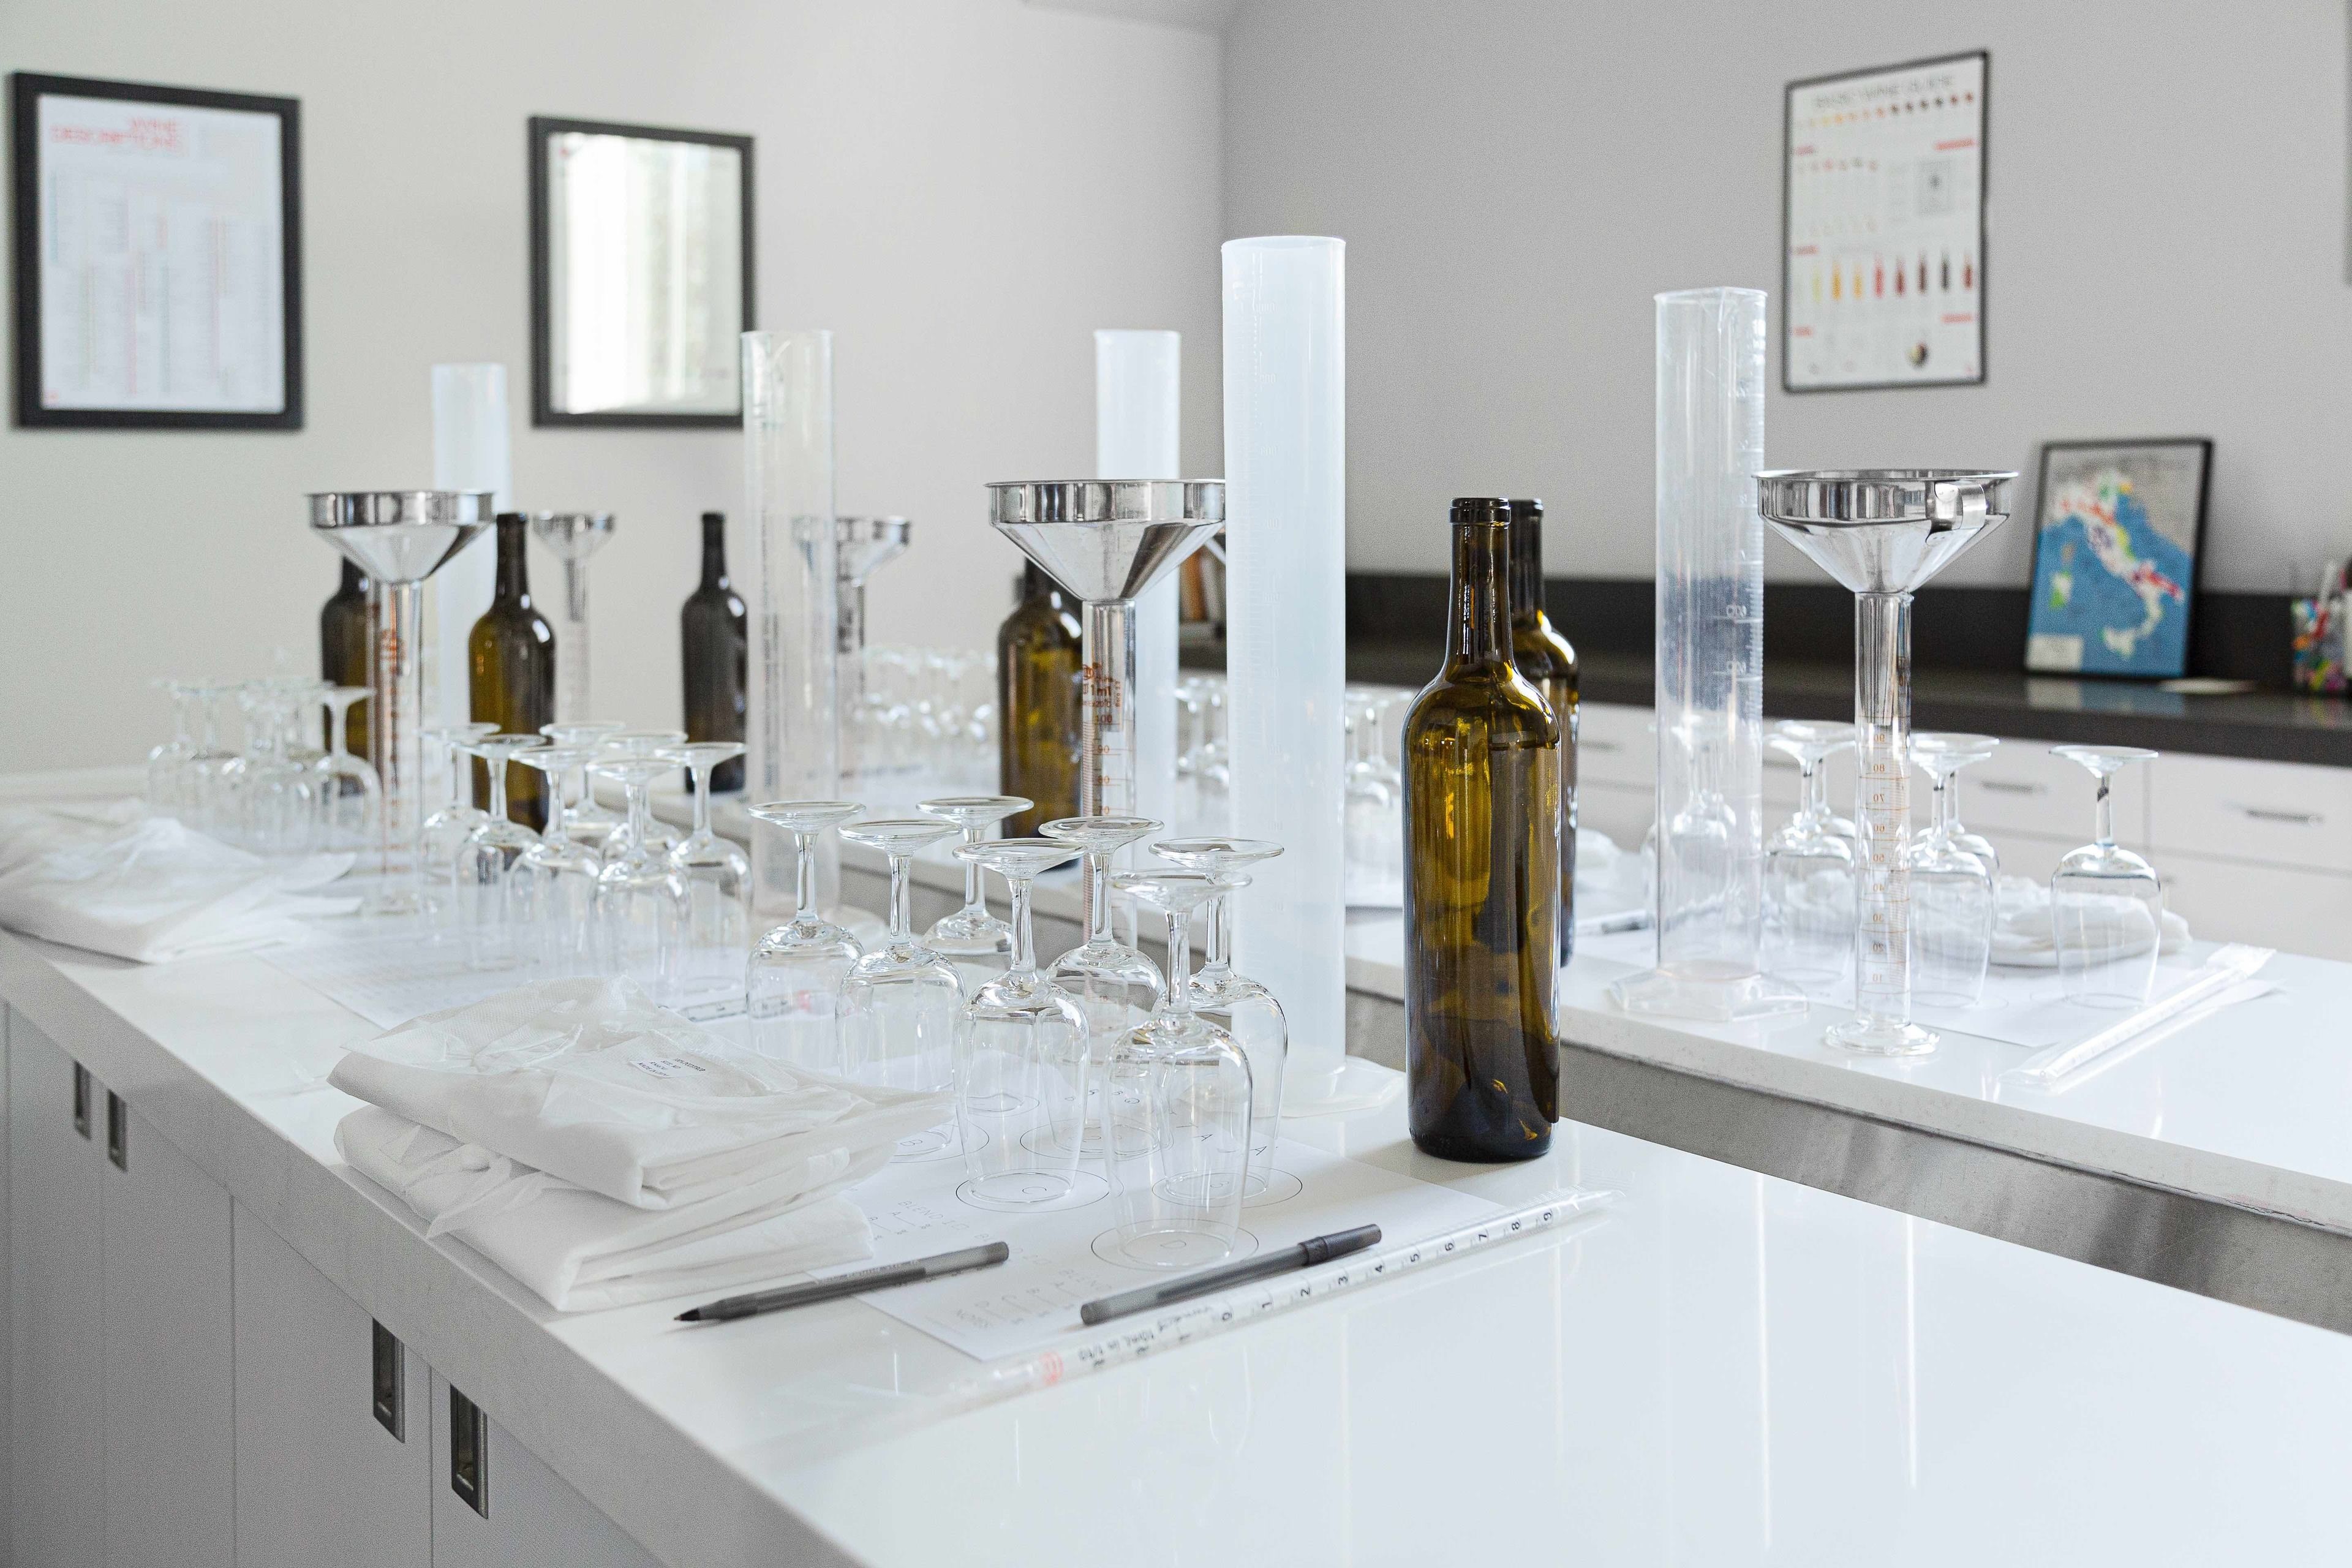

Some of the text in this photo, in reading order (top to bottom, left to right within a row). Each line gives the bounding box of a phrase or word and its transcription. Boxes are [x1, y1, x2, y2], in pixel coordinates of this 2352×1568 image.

[1222, 1311, 1232, 1322] 0
[1300, 1286, 1311, 1297] 2
[1338, 1275, 1348, 1285] 3
[1374, 1264, 1383, 1273] 4
[1409, 1253, 1420, 1262] 5
[1444, 1242, 1455, 1252] 6
[1478, 1232, 1488, 1242] 7
[1511, 1221, 1521, 1231] 8
[1543, 1212, 1553, 1221] 9
